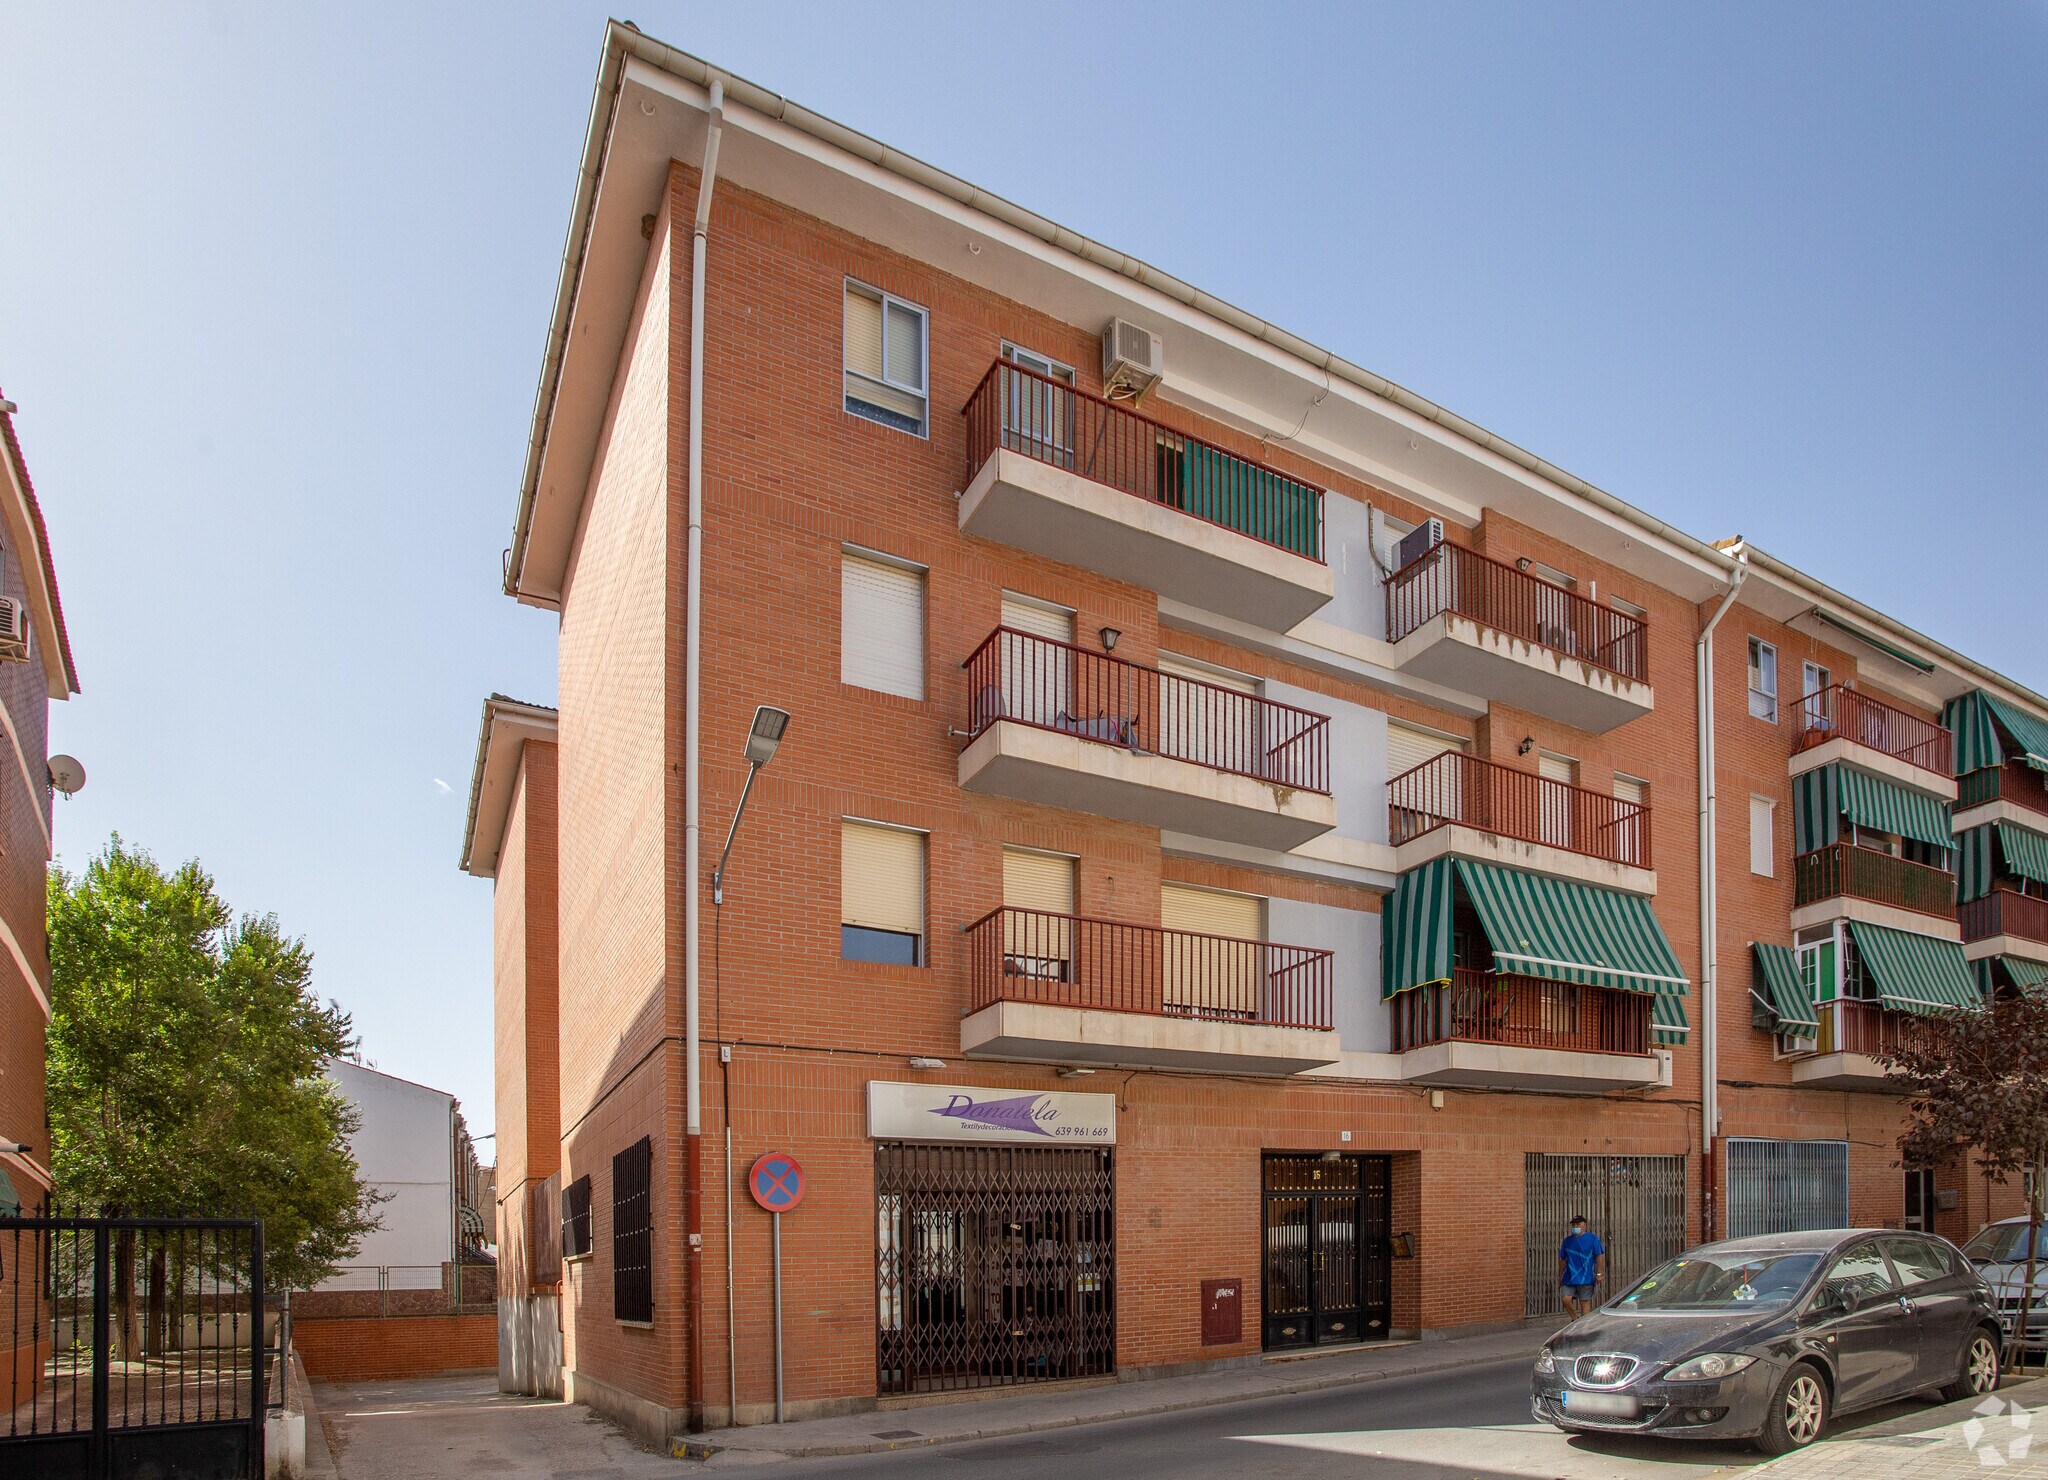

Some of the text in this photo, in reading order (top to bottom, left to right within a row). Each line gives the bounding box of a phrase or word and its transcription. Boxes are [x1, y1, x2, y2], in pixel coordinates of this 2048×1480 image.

[940, 1095, 1061, 1120] Donatela
[1055, 1126, 1108, 1137] 639 961 669
[1313, 1170, 1321, 1180] 16
